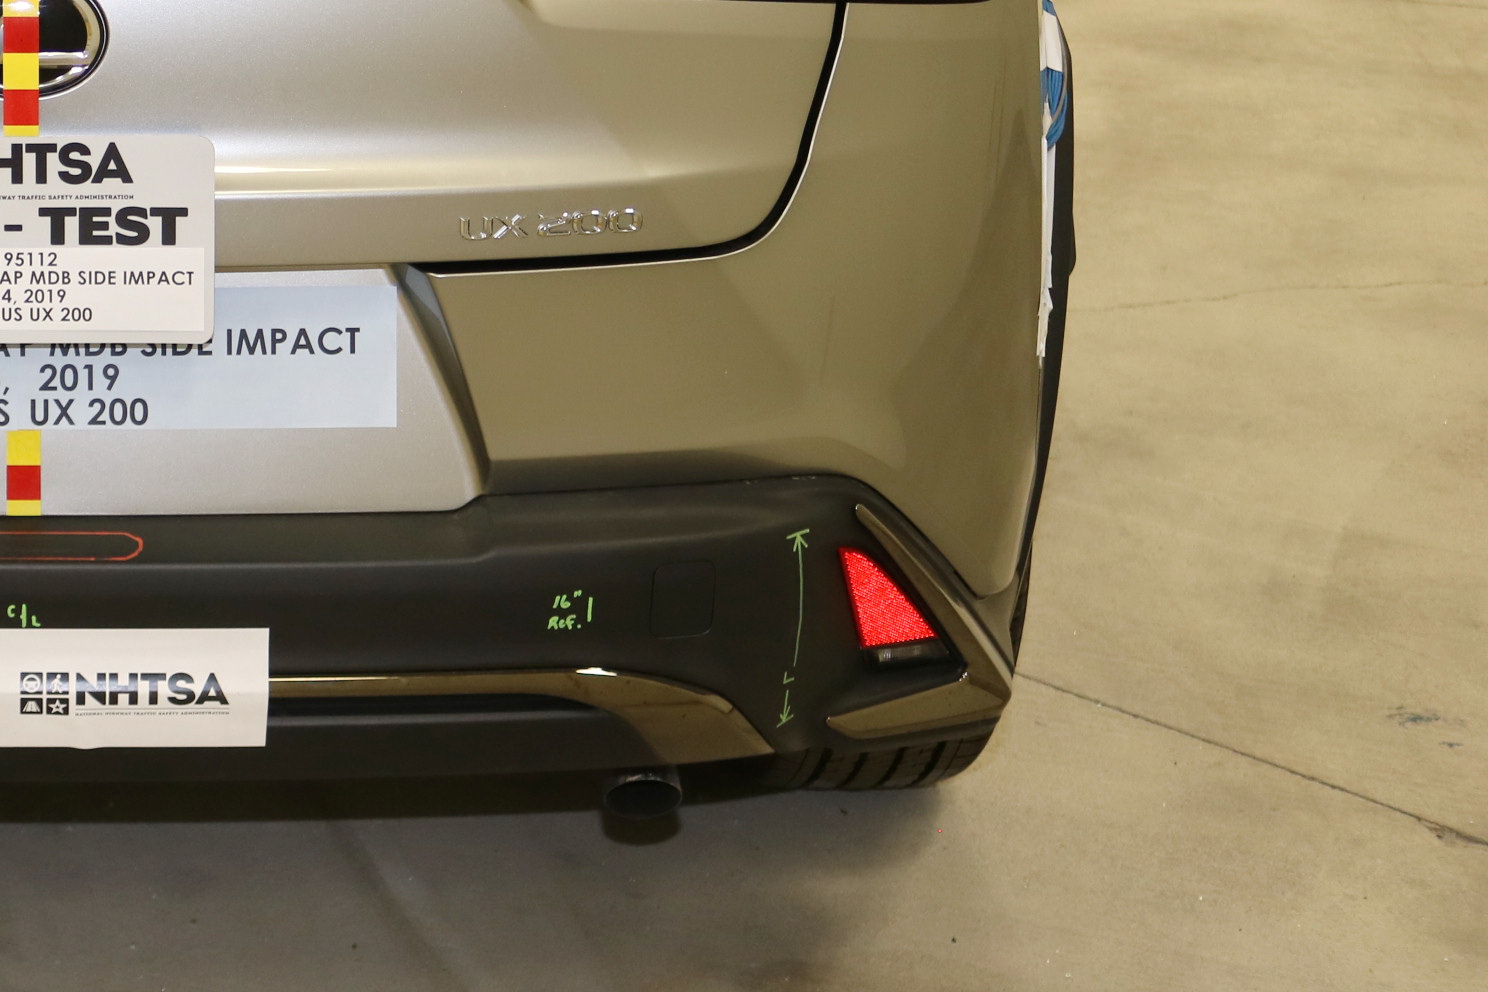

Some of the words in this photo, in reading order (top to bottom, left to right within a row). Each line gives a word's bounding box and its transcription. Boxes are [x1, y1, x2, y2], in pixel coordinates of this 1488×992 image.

[38, 206, 189, 247] TEST
[459, 213, 528, 240] UX
[536, 207, 643, 237] 200
[29, 270, 72, 285] MDB
[78, 270, 117, 286] SIDE
[123, 270, 195, 286] IMPACT
[1, 288, 17, 305] 4,
[23, 288, 67, 304] 2019
[29, 307, 54, 322] UX
[60, 307, 93, 322] 200
[226, 326, 361, 356] IMPACT
[38, 363, 120, 392] 2019
[30, 398, 75, 427] UX
[87, 397, 149, 426] 200
[74, 672, 231, 706] NHTSA
